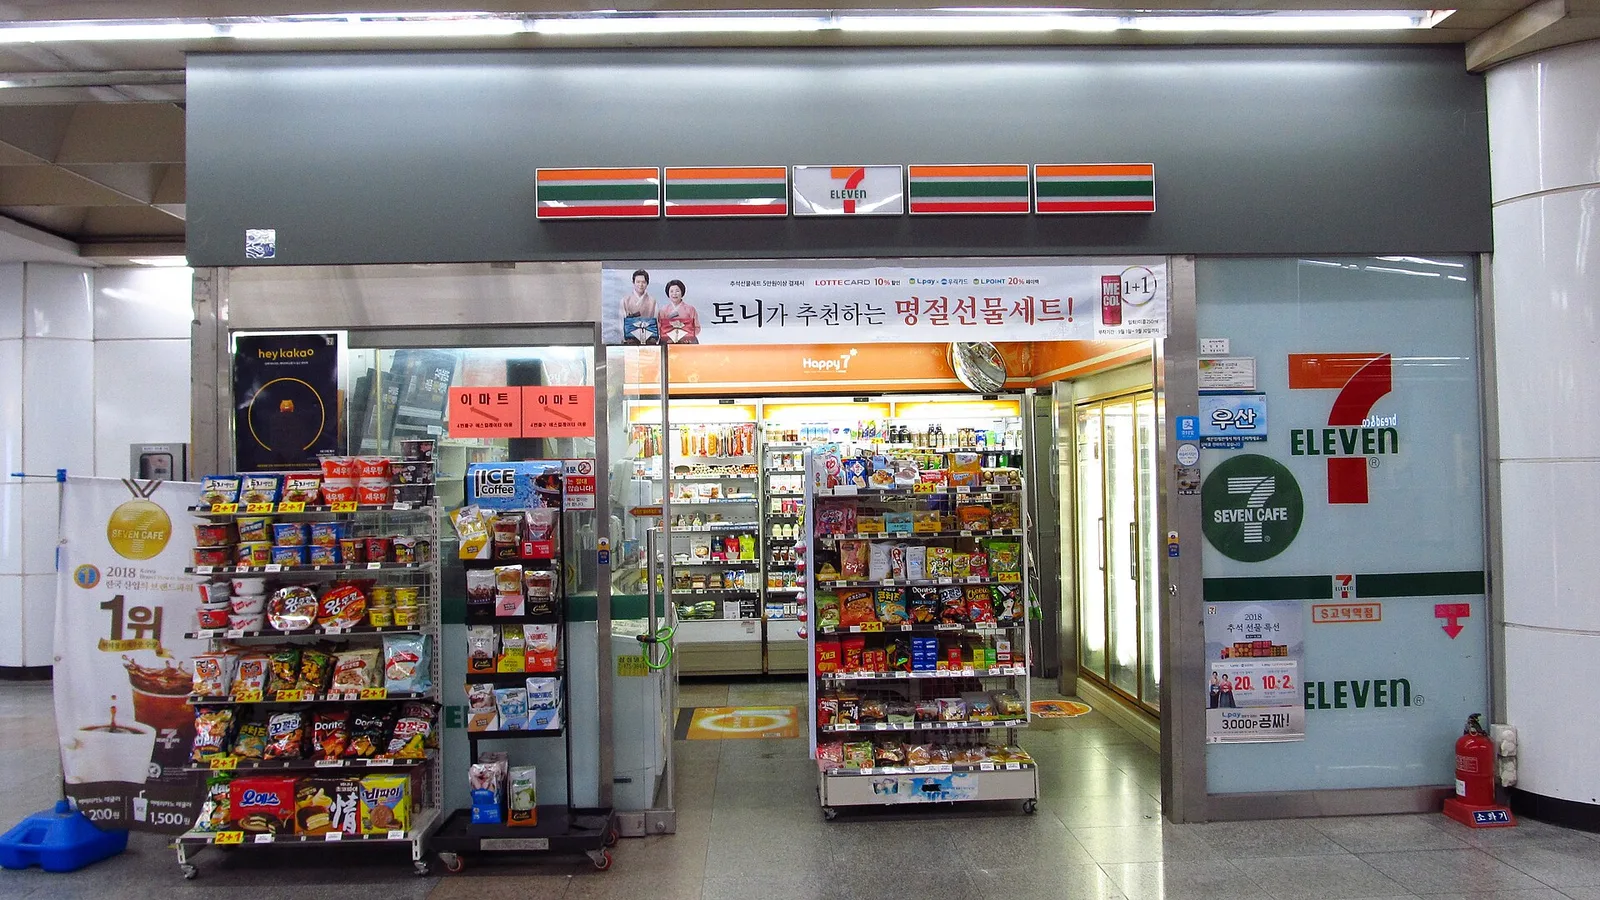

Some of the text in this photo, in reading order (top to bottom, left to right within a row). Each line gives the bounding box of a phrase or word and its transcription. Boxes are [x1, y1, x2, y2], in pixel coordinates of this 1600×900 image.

[874, 278, 890, 286] 10%
[1008, 277, 1025, 286] 20%
[1124, 276, 1151, 295] 1+1
[710, 295, 1074, 328] 토니가 추천하는 명절선물세트!
[258, 348, 314, 361] hey kakao
[803, 354, 851, 371] Happy 7
[1212, 408, 1257, 430] 우산
[1288, 352, 1392, 504] 7
[480, 468, 514, 485] ICE
[480, 484, 514, 494] Coffee
[914, 485, 935, 493] 2+1
[212, 504, 237, 512] 2+1
[247, 504, 272, 512] 2+1
[279, 503, 304, 511] 2+1
[332, 503, 356, 511] 2+1
[1214, 507, 1288, 524] SEVEN CAFE
[106, 566, 137, 579] 2018
[999, 573, 1020, 581] 2+1
[100, 594, 164, 642] 1위
[1244, 613, 1263, 621] 2018
[861, 623, 882, 631] 2+1
[1227, 622, 1244, 633] 추석
[237, 692, 261, 700] 2+1
[277, 691, 301, 699] 2+1
[361, 689, 386, 698] 2+1
[1259, 713, 1290, 729] 공짜!
[212, 759, 236, 768] 2+1
[239, 789, 281, 807] 오예스
[1477, 811, 1509, 822] 소화기
[216, 833, 242, 842] 2+1
